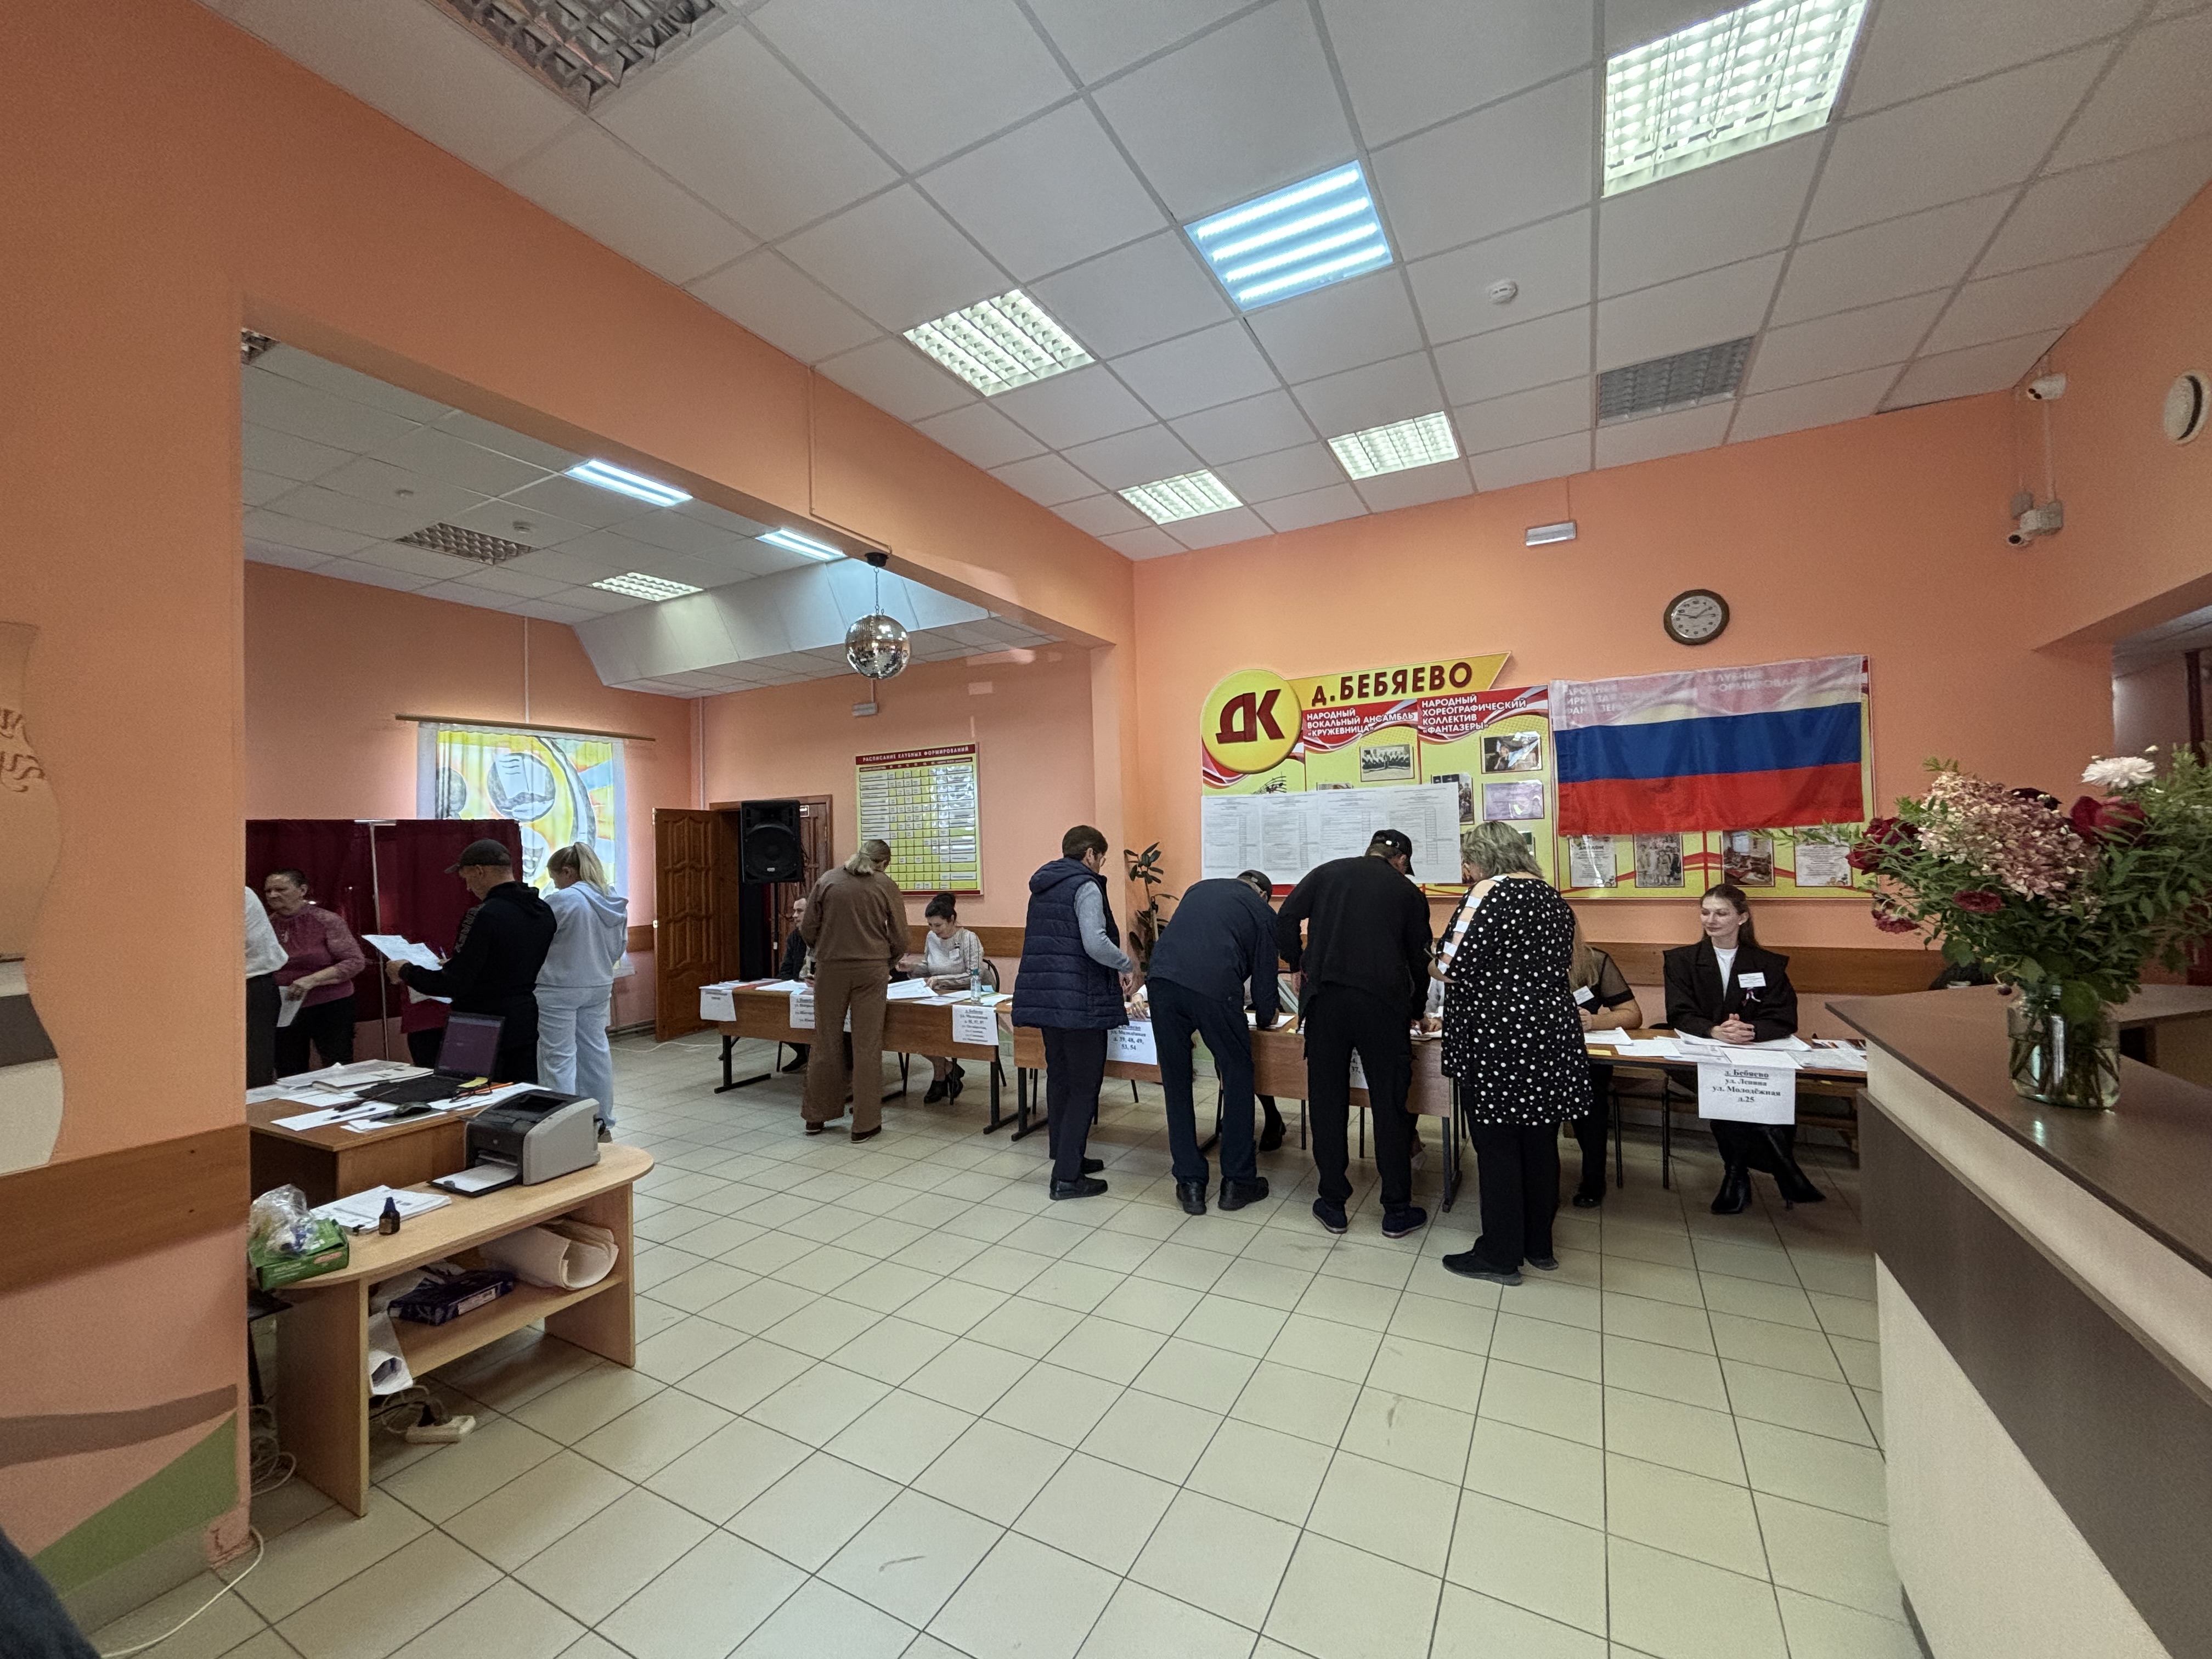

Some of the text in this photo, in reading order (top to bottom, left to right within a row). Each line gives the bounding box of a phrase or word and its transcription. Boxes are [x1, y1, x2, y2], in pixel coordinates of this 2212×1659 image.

[1421, 694, 1477, 708] НАРОДНЫЙ
[1422, 698, 1526, 717] ХОРЕОГРАФИЧЕСКИЙ
[1216, 689, 1285, 744] ДК
[1307, 708, 1356, 720] НАРОДНЫЙ
[1307, 712, 1415, 729] ВОКАЛЬНЫЙ АНСАМБЛЬ
[1423, 713, 1477, 726] КОЛЛЕКТИВ
[862, 753, 896, 762] РАСПИСАНИЕ
[924, 746, 969, 756] ФОРМИРОВАНИЙ
[1733, 1069, 1769, 1079] Бебяево
[1726, 1086, 1781, 1096] Молодёжная
